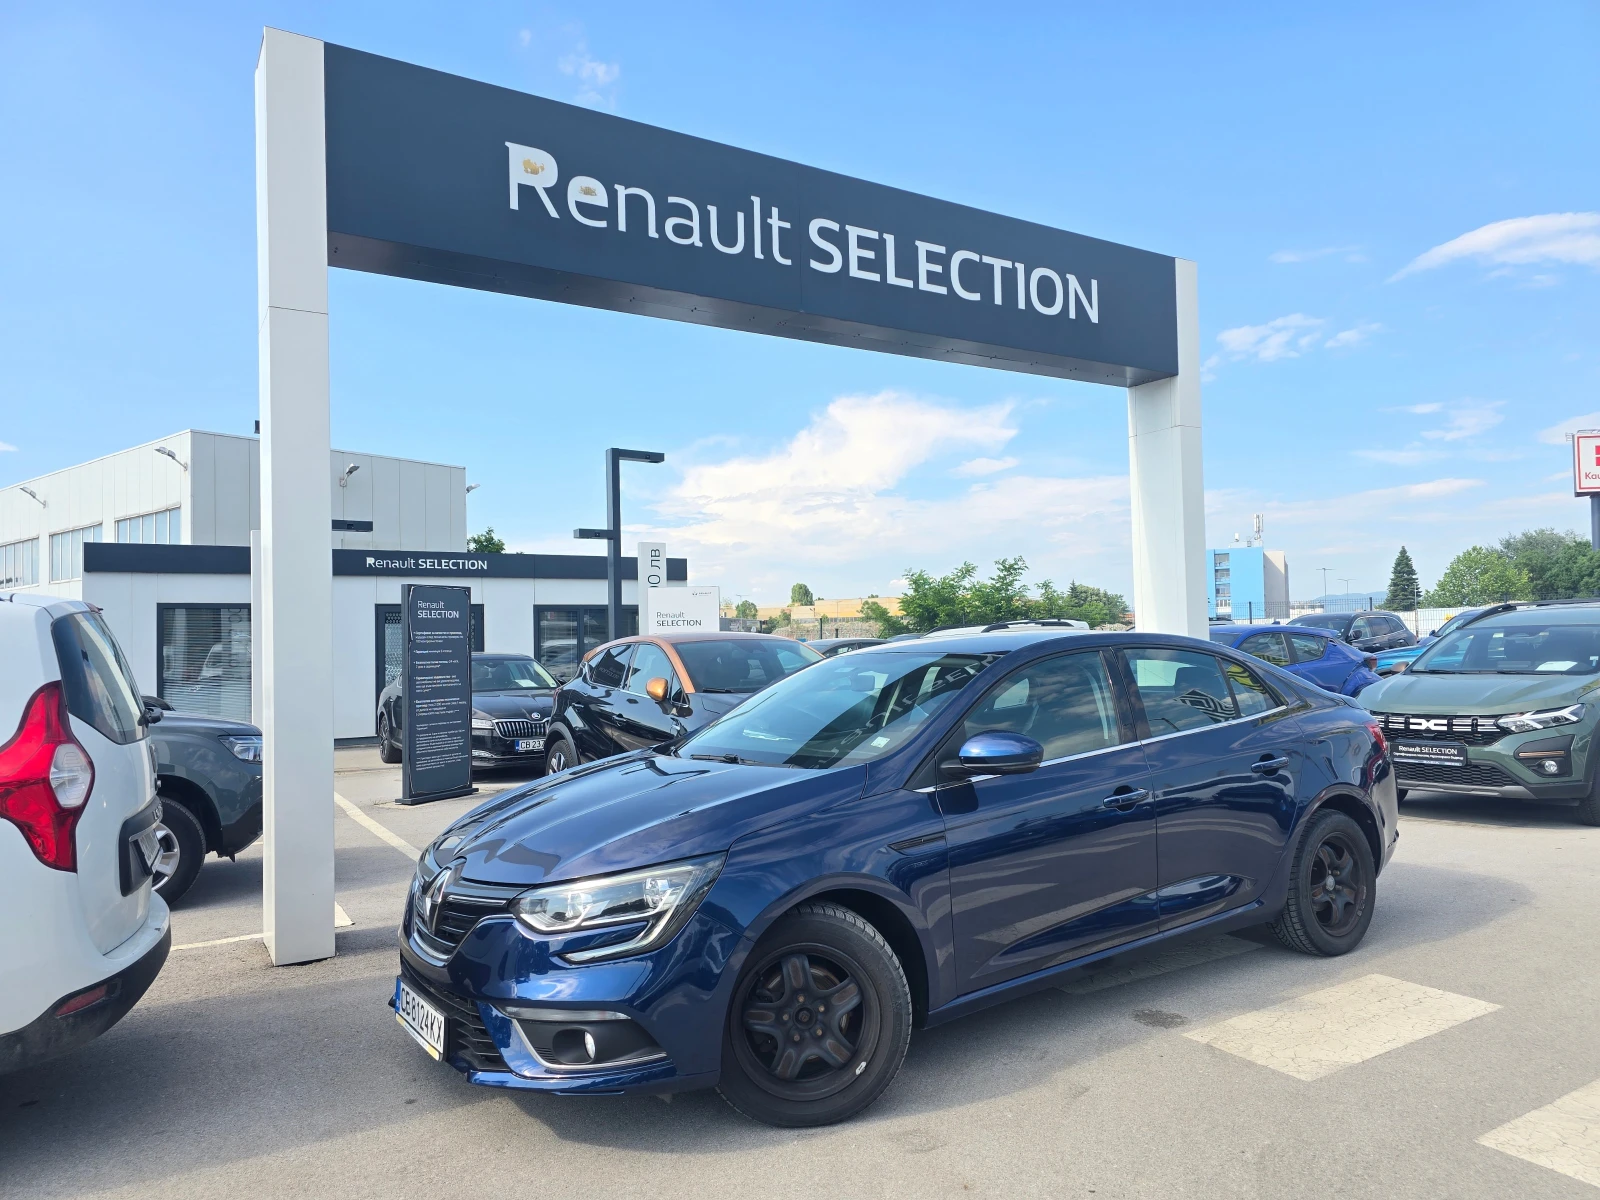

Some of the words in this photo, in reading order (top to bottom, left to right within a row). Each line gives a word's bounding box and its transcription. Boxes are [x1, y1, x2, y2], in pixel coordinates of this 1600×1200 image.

[504, 141, 792, 266] Renault
[809, 217, 1100, 325] SELECTION
[365, 556, 416, 569] Renault
[418, 558, 488, 570] SELECTION
[417, 600, 445, 609] Renault
[417, 610, 460, 619] SELECTION
[656, 611, 685, 619] Renault
[656, 619, 702, 627] SELECTION
[1398, 745, 1420, 753] Renault
[1421, 746, 1458, 755] SELECTION
